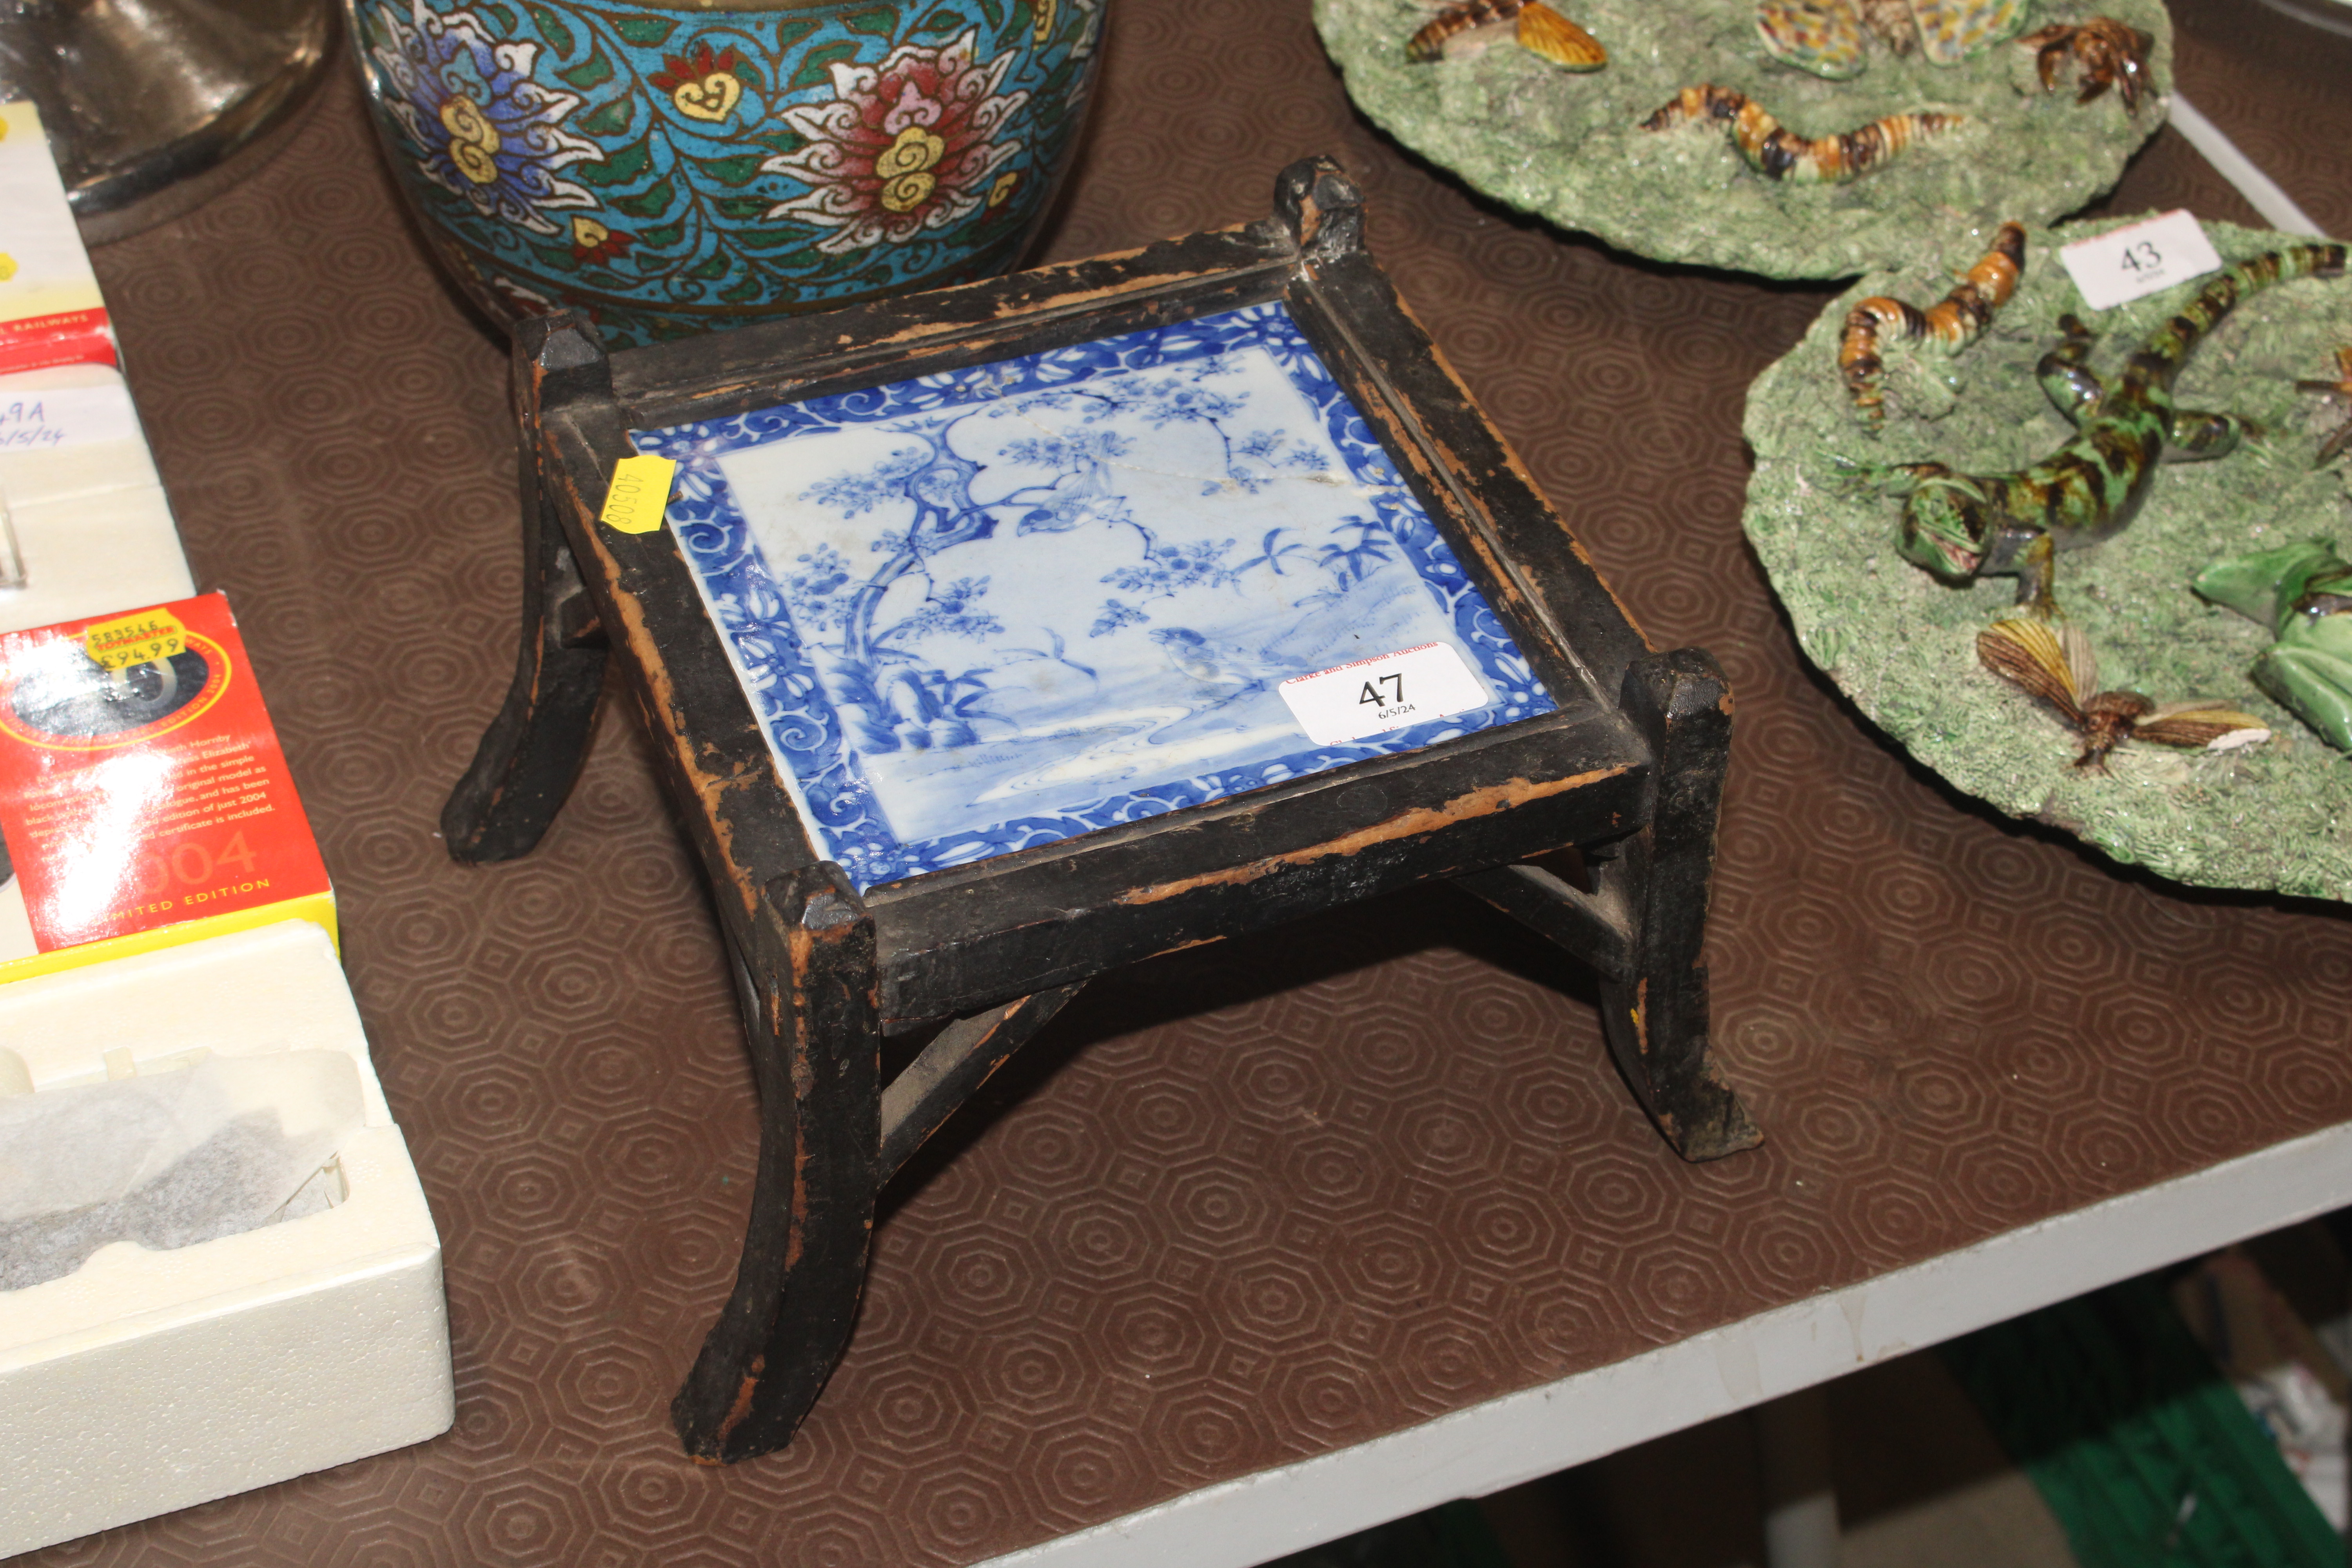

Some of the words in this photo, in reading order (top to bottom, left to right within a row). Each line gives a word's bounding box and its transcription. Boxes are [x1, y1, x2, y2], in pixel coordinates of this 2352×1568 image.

[2122, 240, 2161, 271] 43
[606, 474, 643, 524] 40508
[101, 638, 179, 669] £94.99
[1359, 673, 1403, 707] 47
[160, 697, 208, 728] EDITION
[1378, 704, 1416, 719] 6/5/24
[190, 735, 230, 748] Hornby
[187, 768, 197, 777] in
[200, 764, 218, 773] the
[220, 755, 254, 768] simple
[25, 815, 53, 825] black
[176, 776, 215, 791] original
[218, 768, 252, 782] model
[255, 766, 267, 774] as
[200, 789, 220, 800] and
[222, 785, 241, 794] has
[243, 779, 270, 789] been
[159, 819, 213, 837] certificate
[227, 804, 275, 820] included.
[163, 808, 200, 822] edition
[203, 803, 214, 813] of
[217, 800, 237, 811] just
[239, 791, 267, 804] 2004
[134, 829, 257, 895] 004
[184, 878, 270, 905] EDITION
